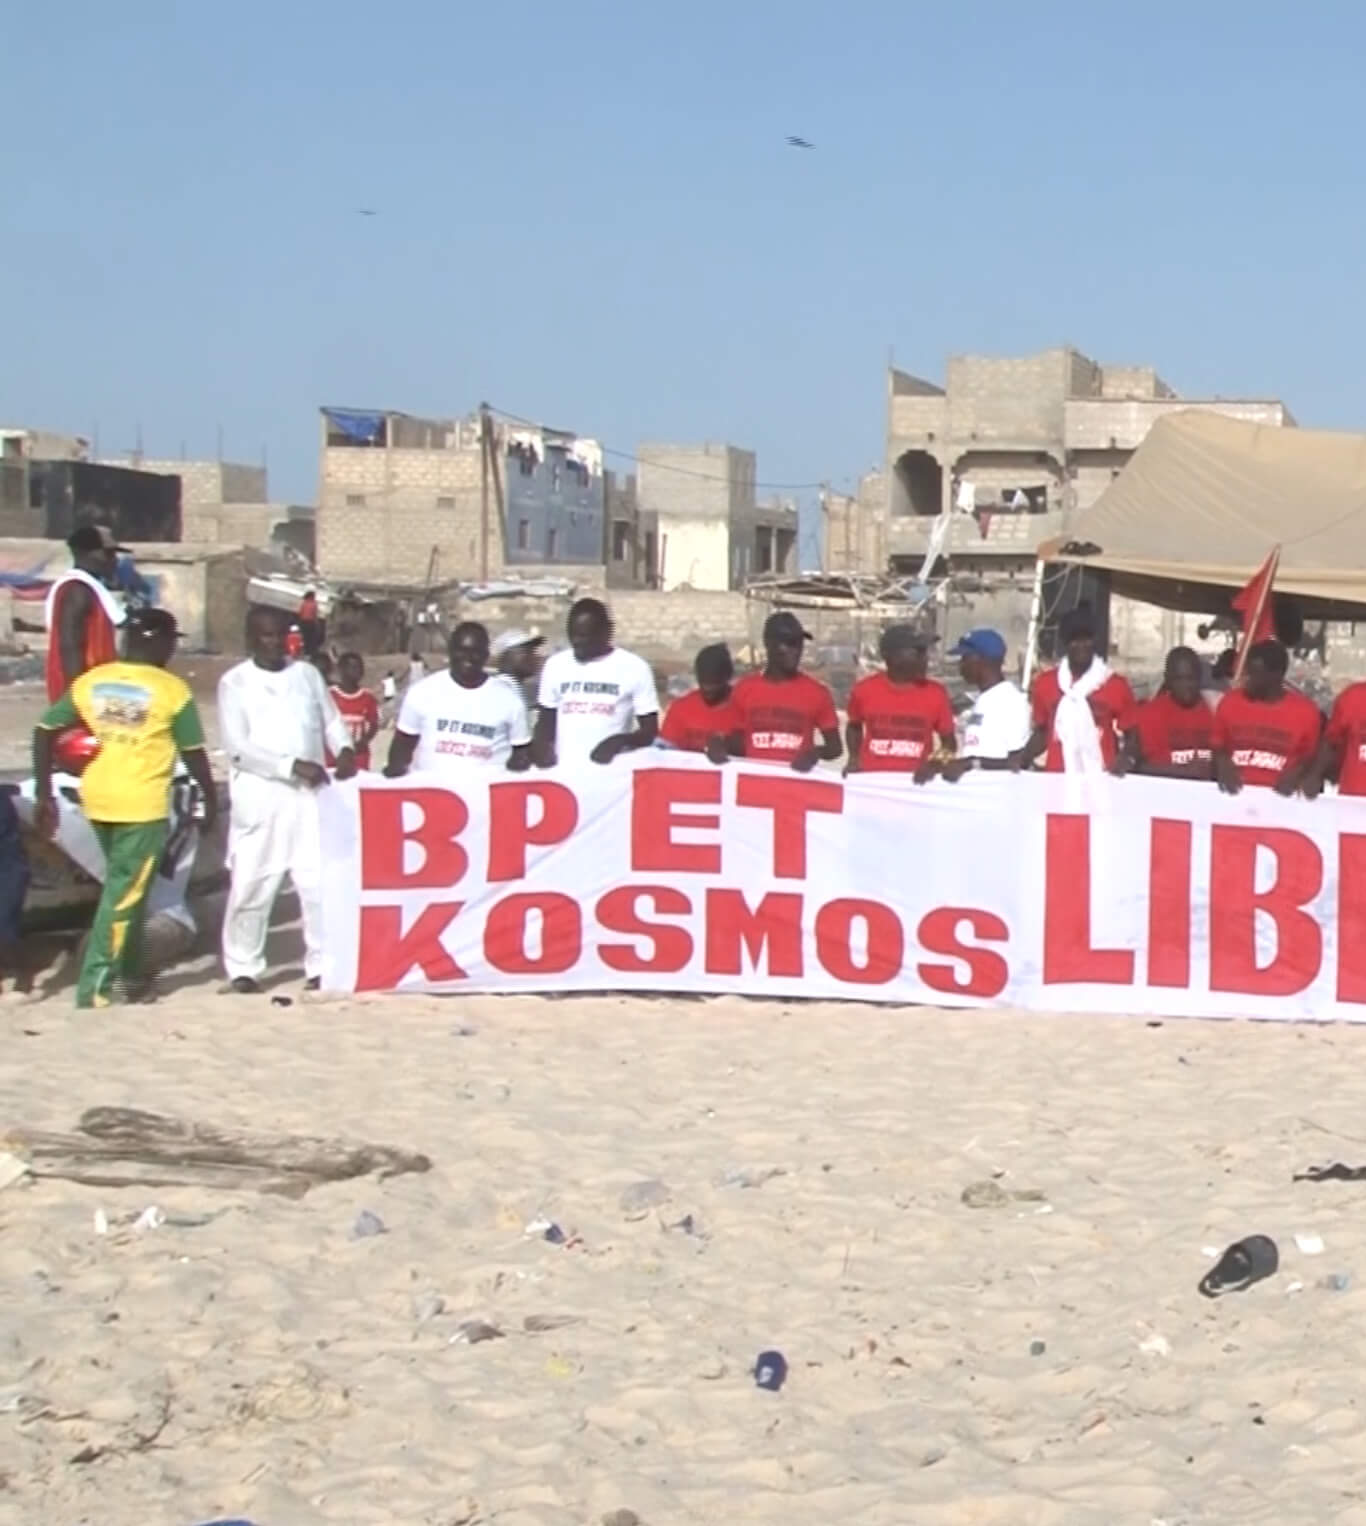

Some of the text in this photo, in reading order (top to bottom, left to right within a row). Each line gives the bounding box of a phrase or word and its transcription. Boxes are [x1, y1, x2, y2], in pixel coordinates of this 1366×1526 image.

[359, 767, 844, 890] BP ET
[354, 886, 1010, 998] KOSMOS
